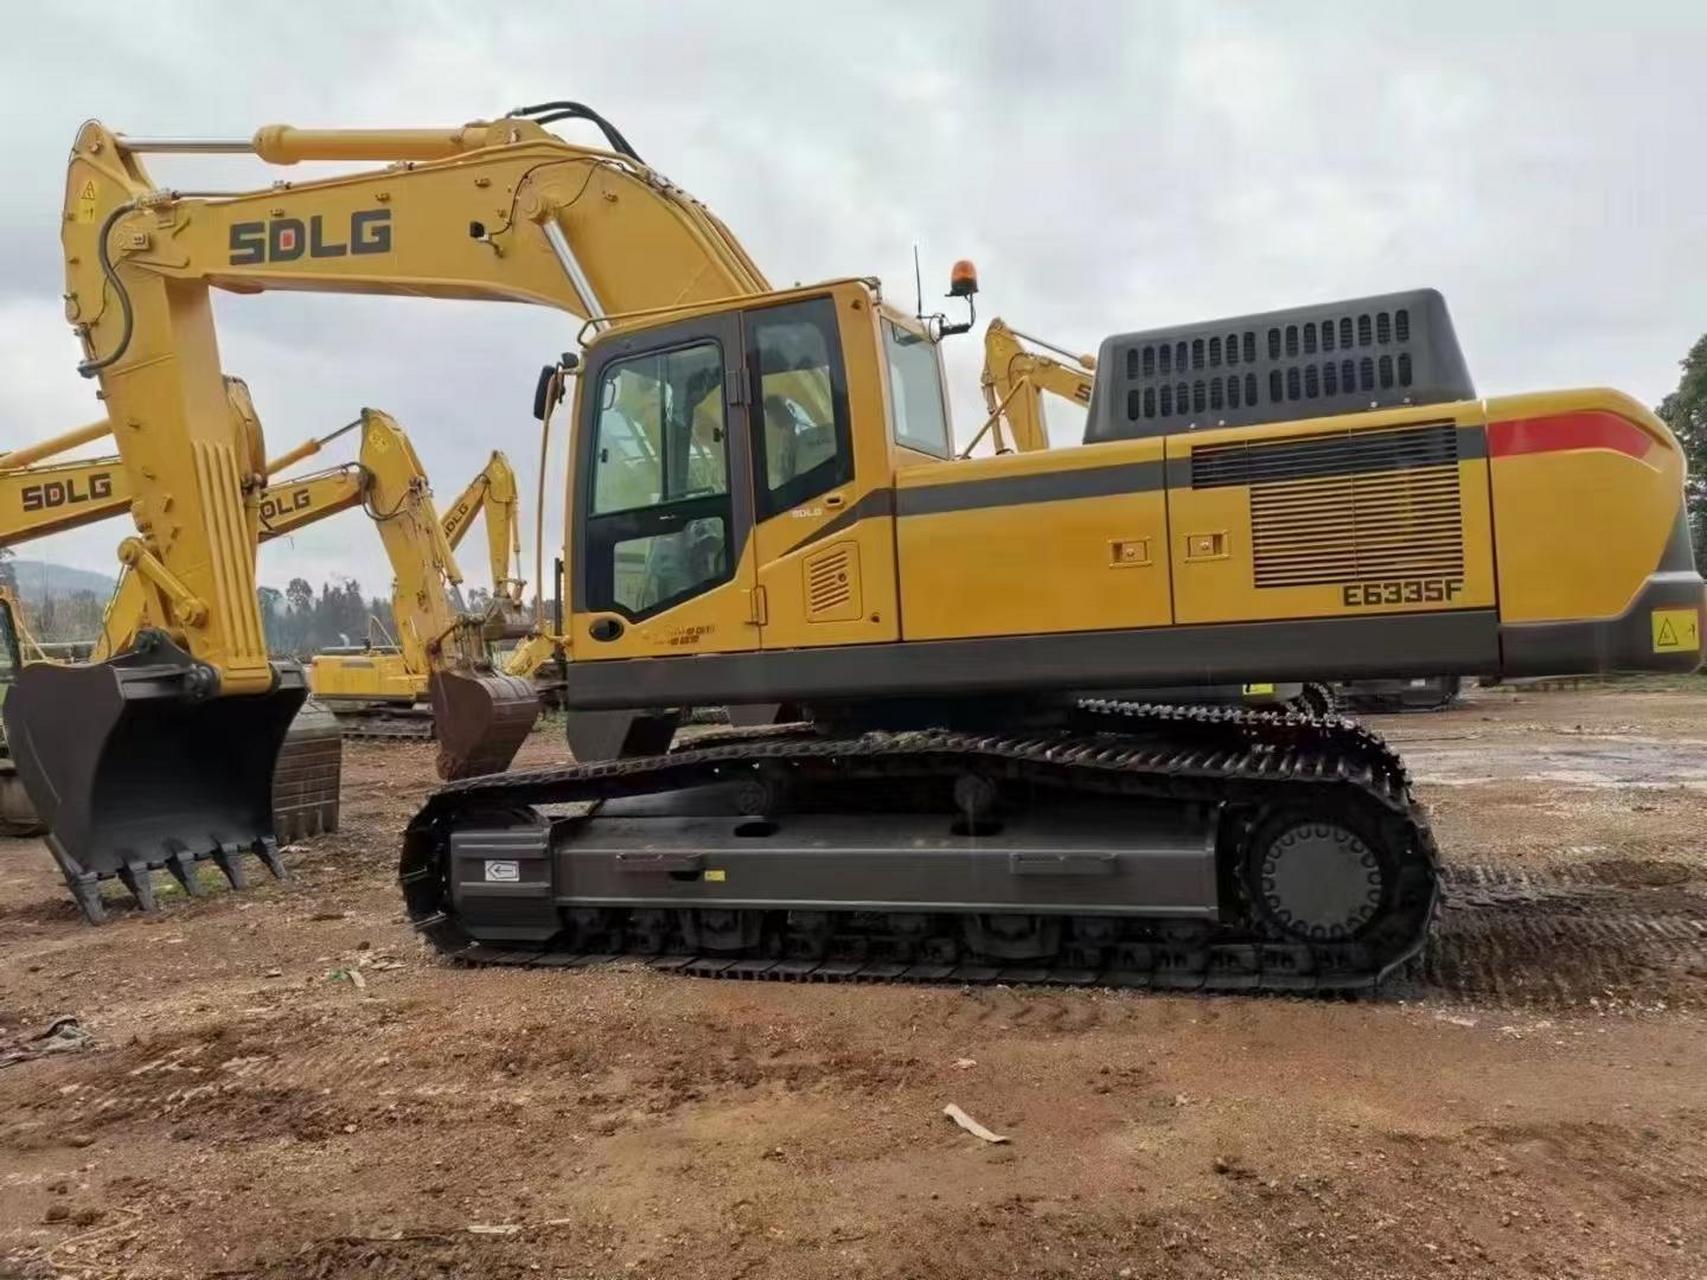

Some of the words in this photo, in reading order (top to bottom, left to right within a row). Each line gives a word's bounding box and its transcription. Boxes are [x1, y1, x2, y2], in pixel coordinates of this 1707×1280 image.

[230, 209, 391, 265] SDLG
[22, 473, 112, 512] SDLG
[260, 488, 310, 518] DLG
[1343, 579, 1464, 606] E6335F
